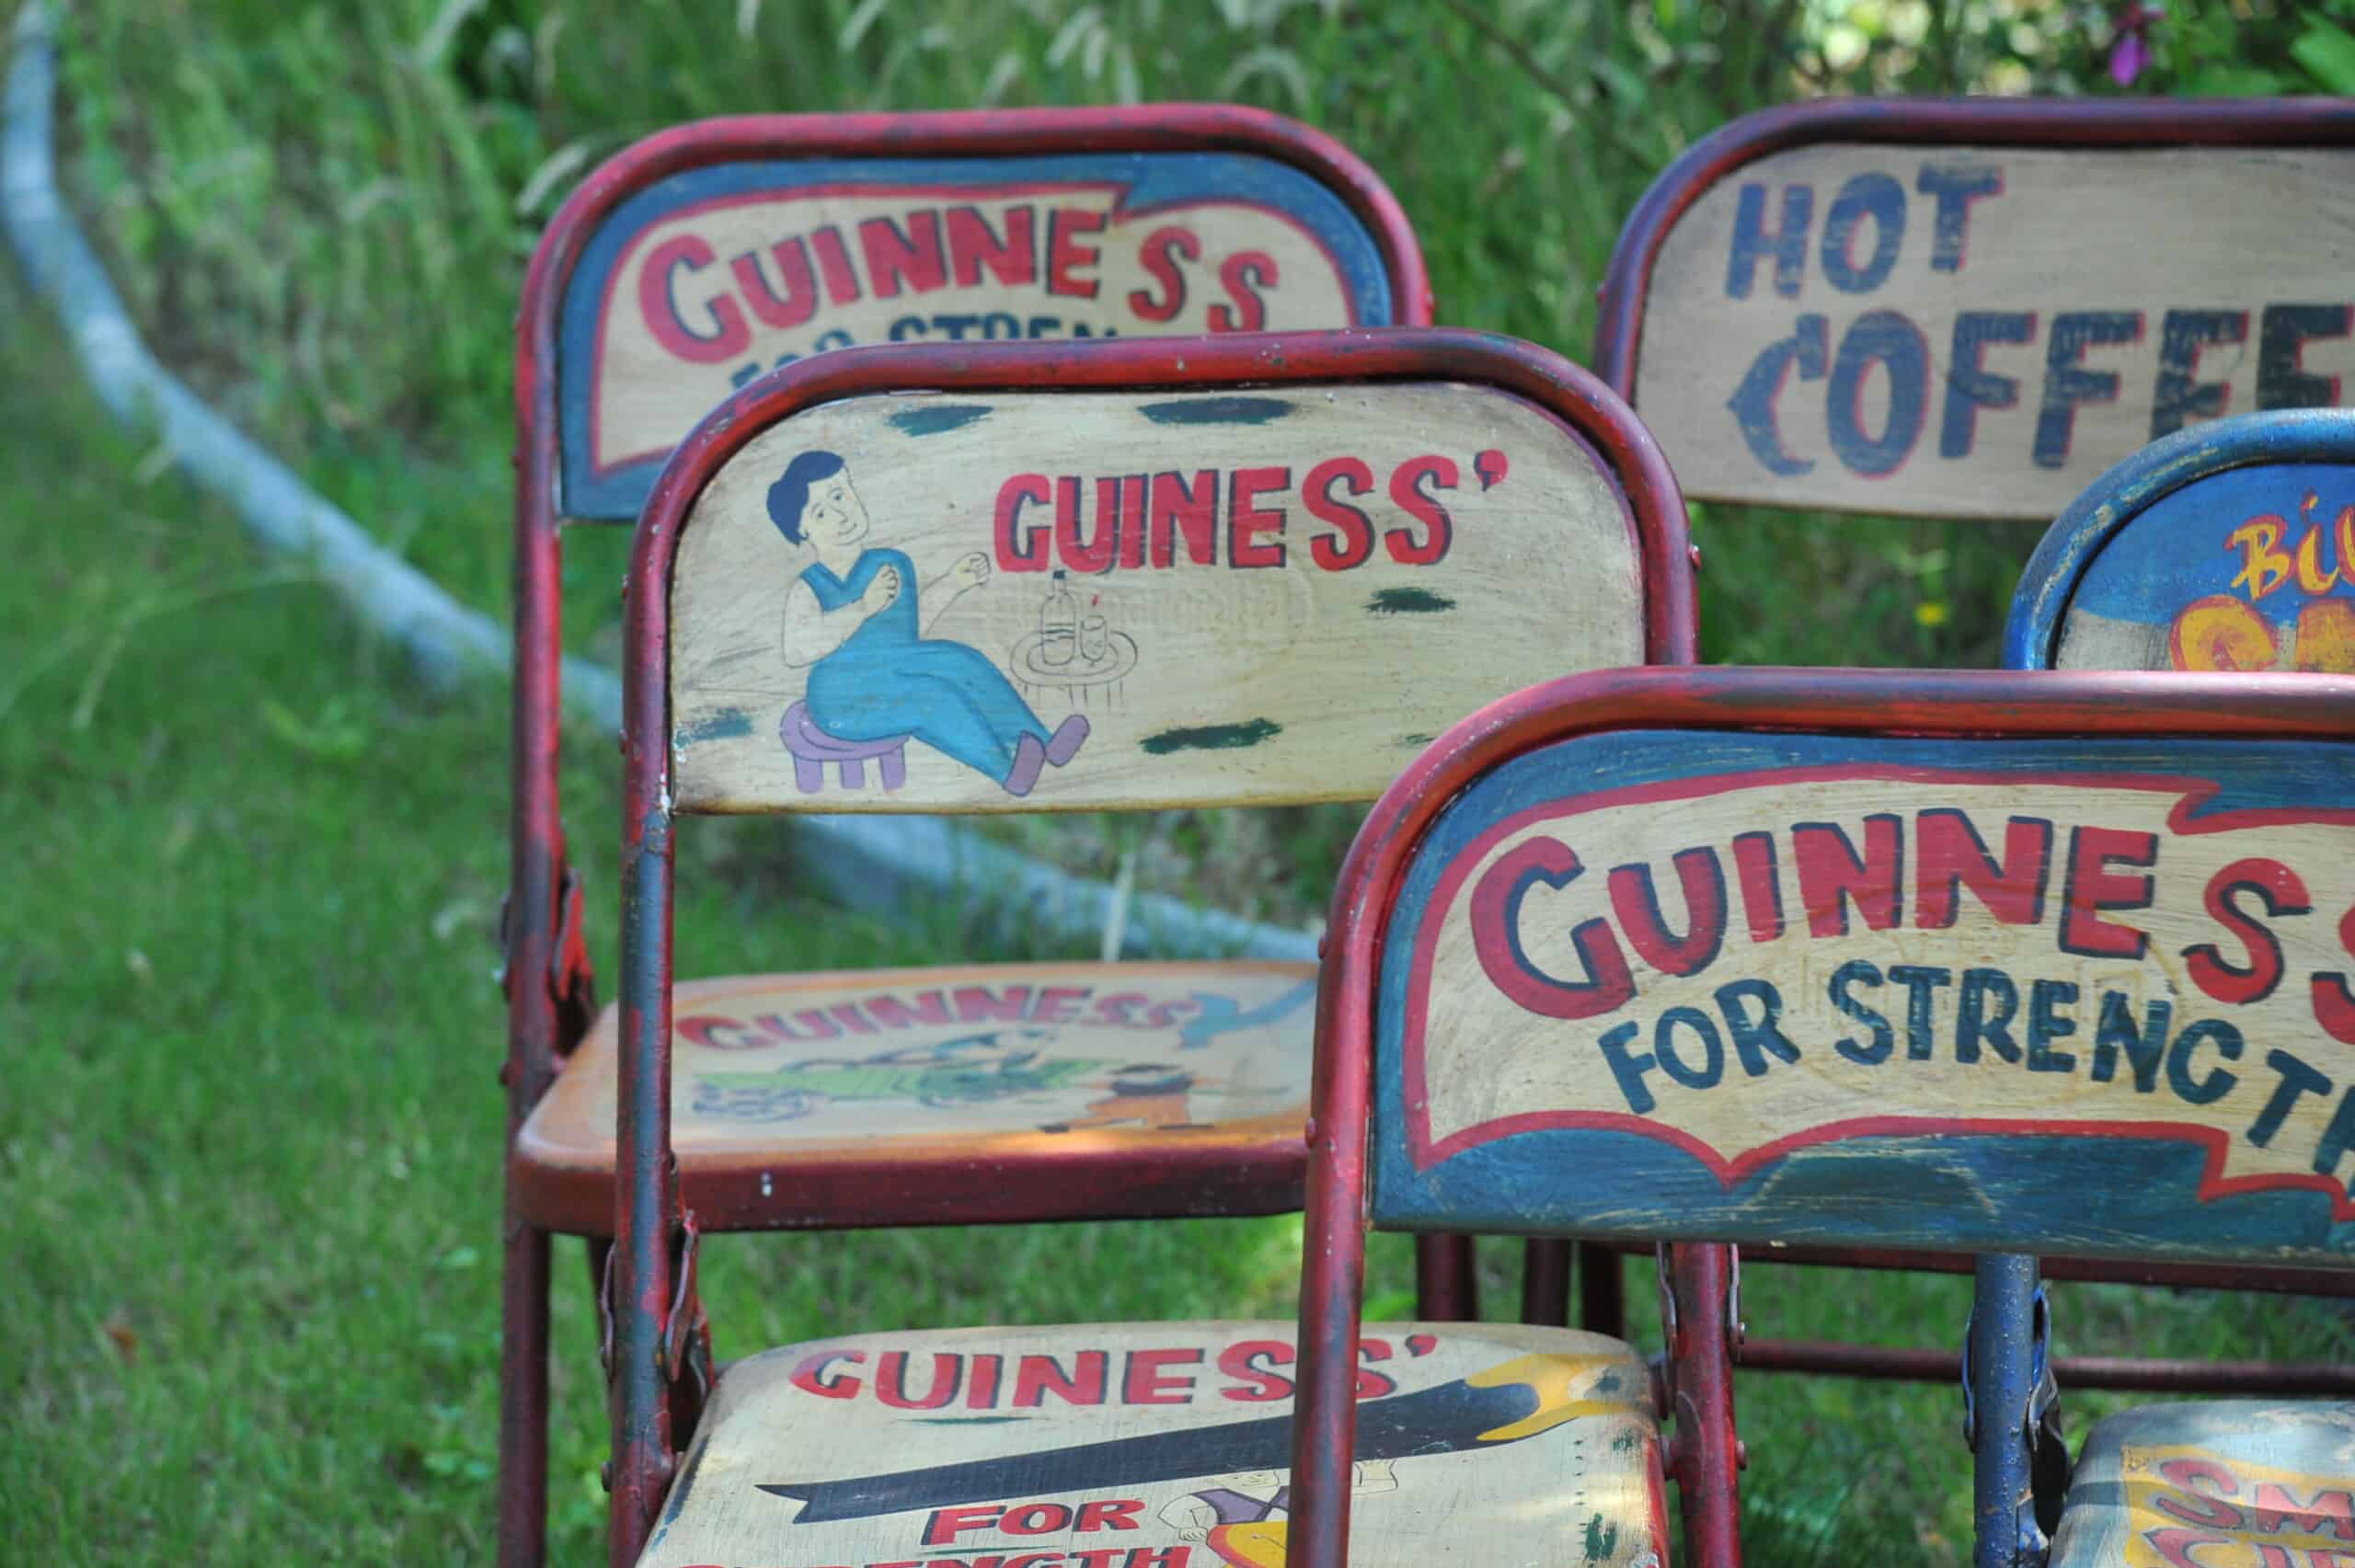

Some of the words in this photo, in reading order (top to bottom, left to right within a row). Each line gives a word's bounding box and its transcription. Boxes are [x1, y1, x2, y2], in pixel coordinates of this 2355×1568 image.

[638, 204, 1280, 364] GUINNESS
[1724, 163, 2006, 300] HOT
[992, 448, 1510, 575] GUINESS'
[675, 985, 1201, 1050] GUINNESS
[1597, 978, 1802, 1116] FOR
[920, 1499, 1146, 1546] FOR
